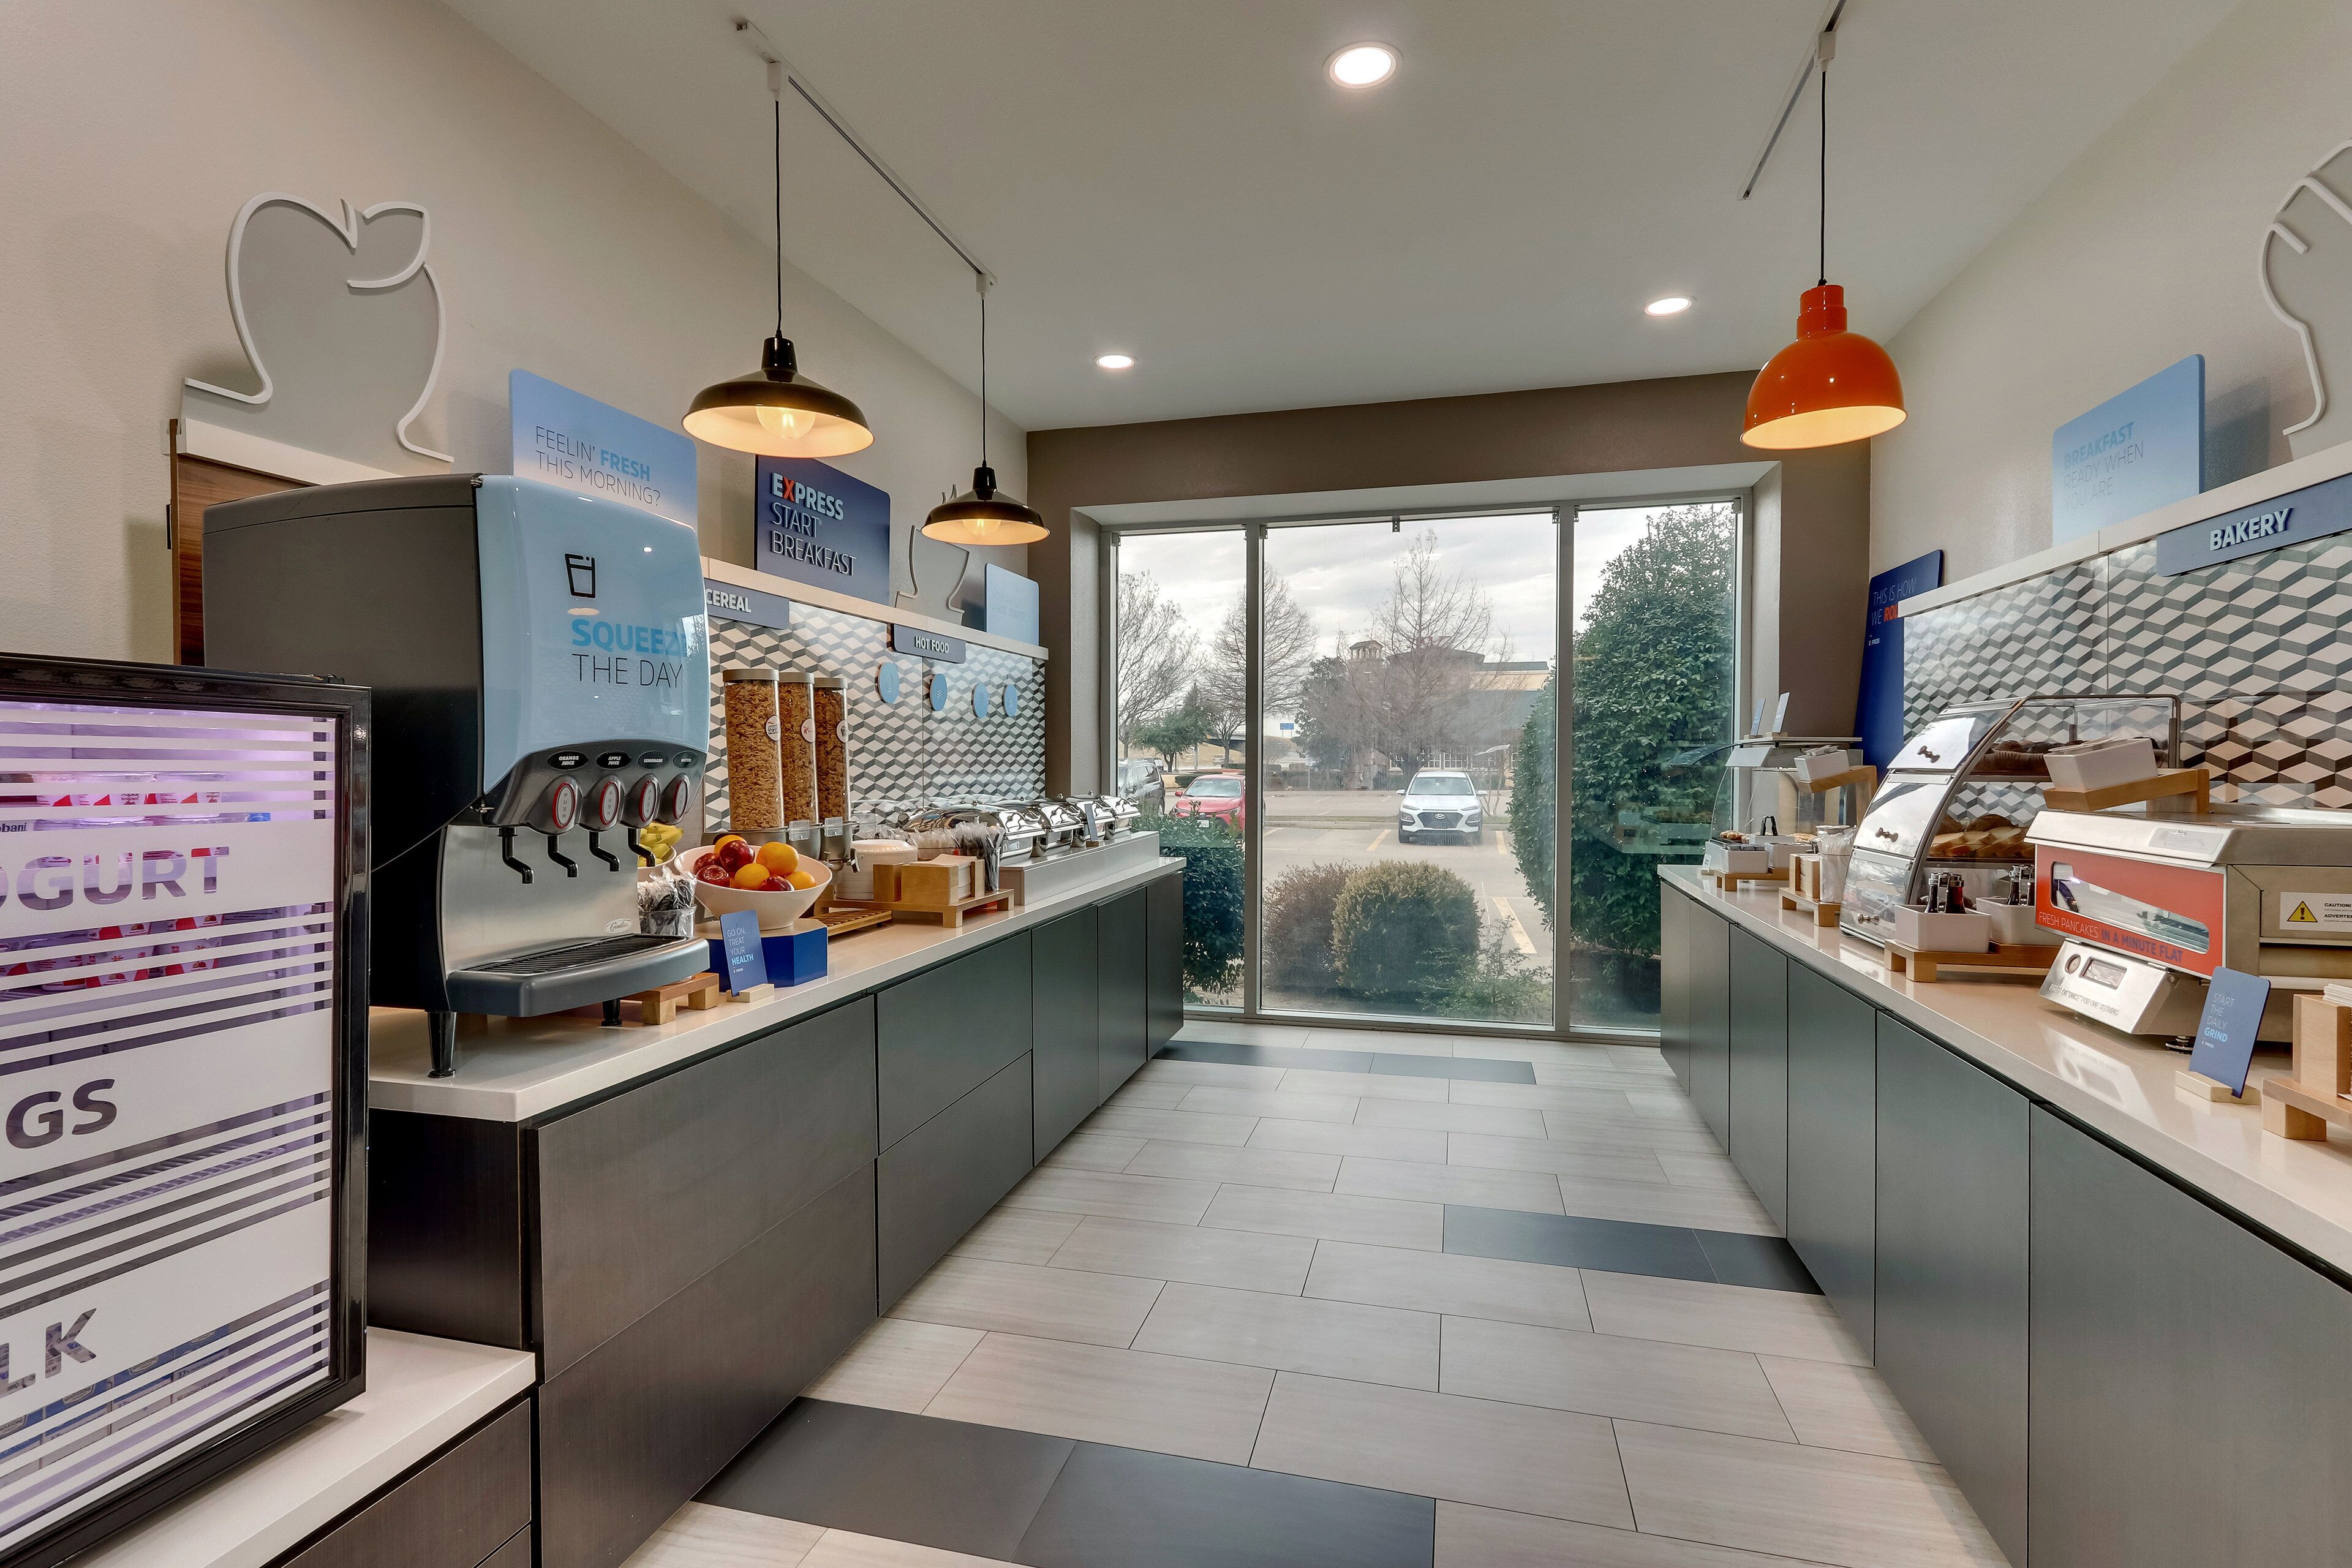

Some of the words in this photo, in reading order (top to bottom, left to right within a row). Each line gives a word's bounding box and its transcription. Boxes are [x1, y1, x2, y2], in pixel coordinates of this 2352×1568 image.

[2064, 421, 2134, 470] BREAKFAST
[600, 449, 650, 481] FRESH
[2064, 460, 2100, 489] READY
[2105, 440, 2143, 473] WHEN
[536, 450, 573, 479] THIS
[580, 465, 660, 507] MORNING?
[771, 472, 844, 521] EXPRESS
[2065, 489, 2086, 510] YOU
[2090, 477, 2113, 502] ARE
[2210, 508, 2292, 551] BAKERY
[771, 530, 857, 576] BREAKFAST
[706, 588, 752, 613] CEREAL
[1874, 588, 1888, 607] THIS
[1889, 584, 1896, 601] IS
[1896, 578, 1917, 599] HOW
[1871, 608, 1883, 626] WE
[914, 636, 930, 649] HOT
[930, 639, 949, 654] FOOD
[571, 653, 628, 685] THE
[640, 660, 682, 688] DAY
[0, 823, 27, 832] bani
[0, 846, 230, 911] GURT
[727, 929, 735, 937] GO
[728, 937, 745, 947] TREAT
[2039, 911, 2060, 927] FRESH
[2061, 918, 2098, 939] PANCAKES
[2101, 929, 2110, 941] IN
[2113, 932, 2119, 944] A
[2122, 935, 2157, 956] MINUTE
[2160, 945, 2183, 962] FLAT
[730, 946, 745, 956] YOUR
[731, 953, 755, 966] HEALTH
[2099, 1003, 2120, 1017] SERVING
[2211, 1004, 2225, 1017] THE
[2212, 993, 2235, 1008] START
[2204, 1027, 2228, 1042] GRIND
[2207, 1016, 2228, 1030] DAILY
[6, 1079, 118, 1149] GS
